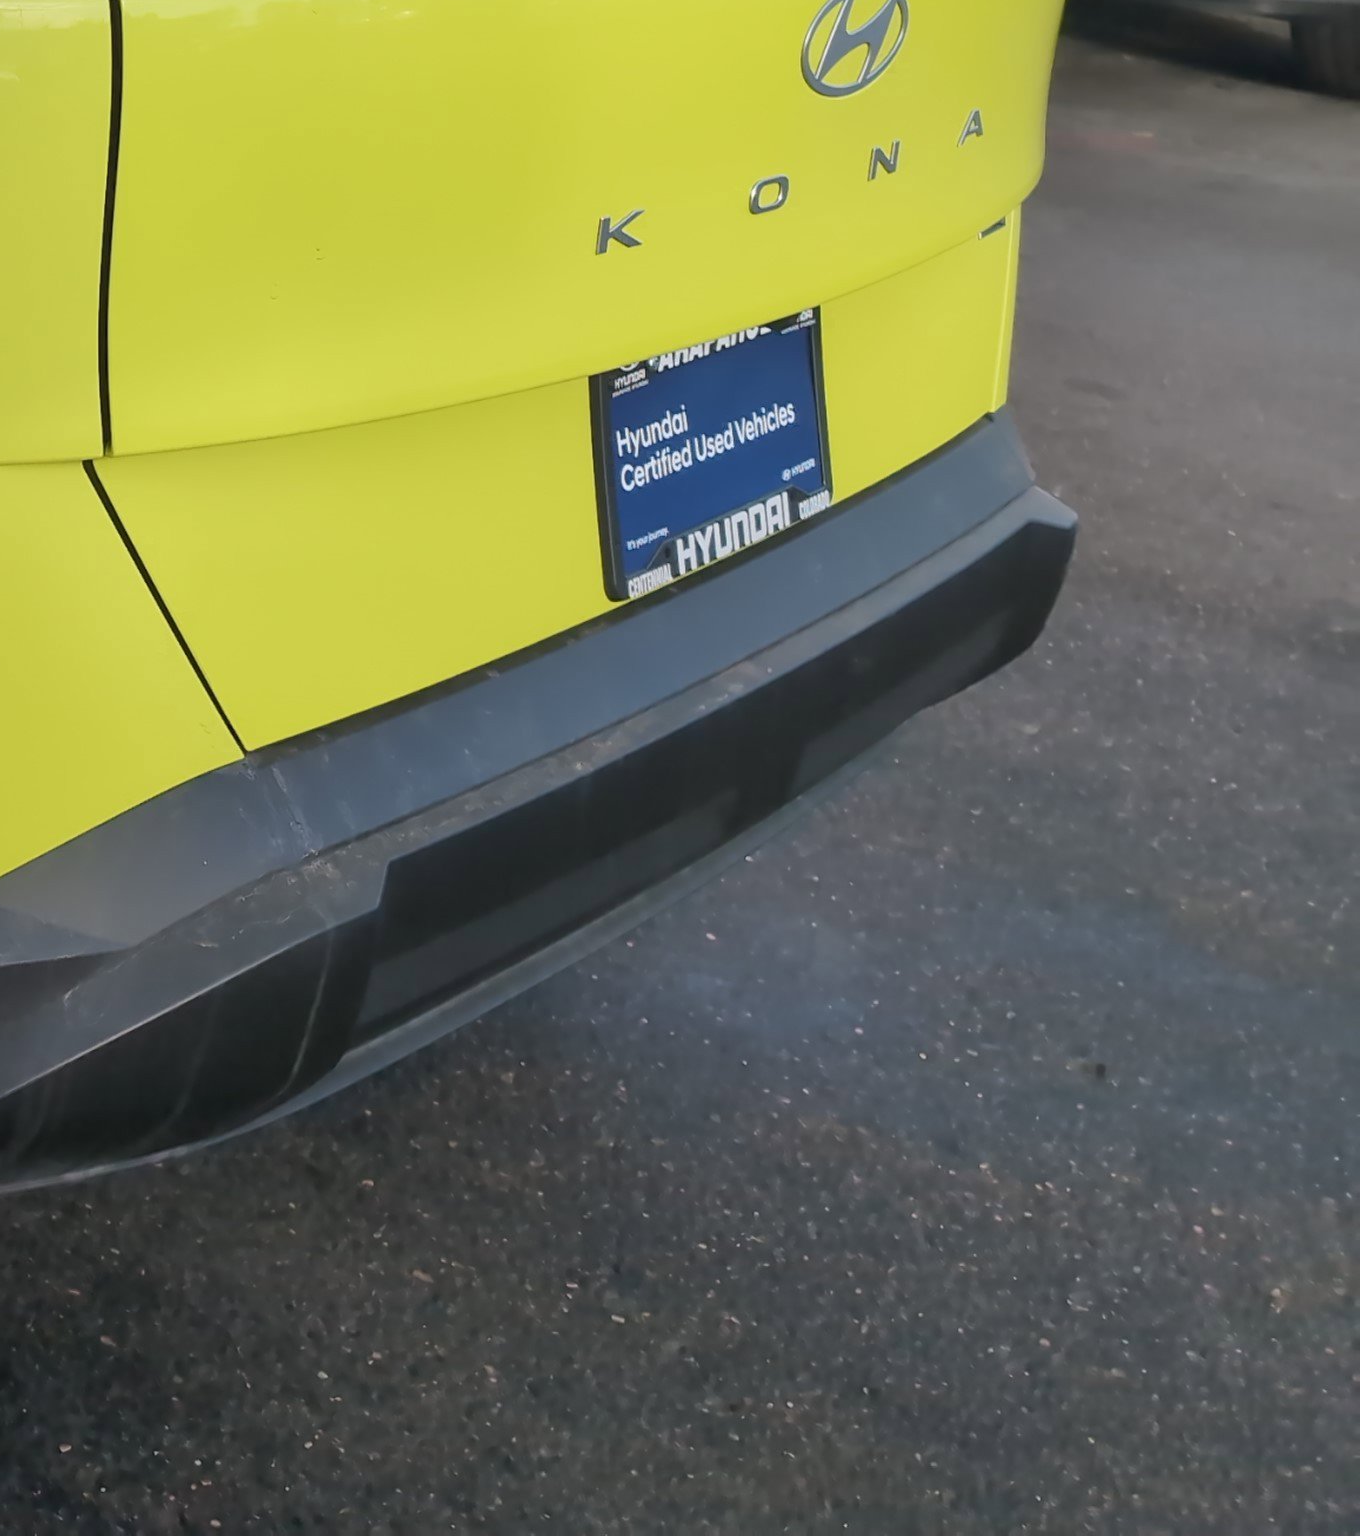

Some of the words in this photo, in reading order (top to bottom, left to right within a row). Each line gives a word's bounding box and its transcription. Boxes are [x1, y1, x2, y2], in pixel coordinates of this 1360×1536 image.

[595, 109, 984, 256] KONA
[615, 404, 689, 458] Hyundai
[620, 439, 693, 492] Certified
[694, 422, 735, 462] Used
[735, 402, 796, 444] Vehicles
[676, 491, 791, 576] HYUNDAI
